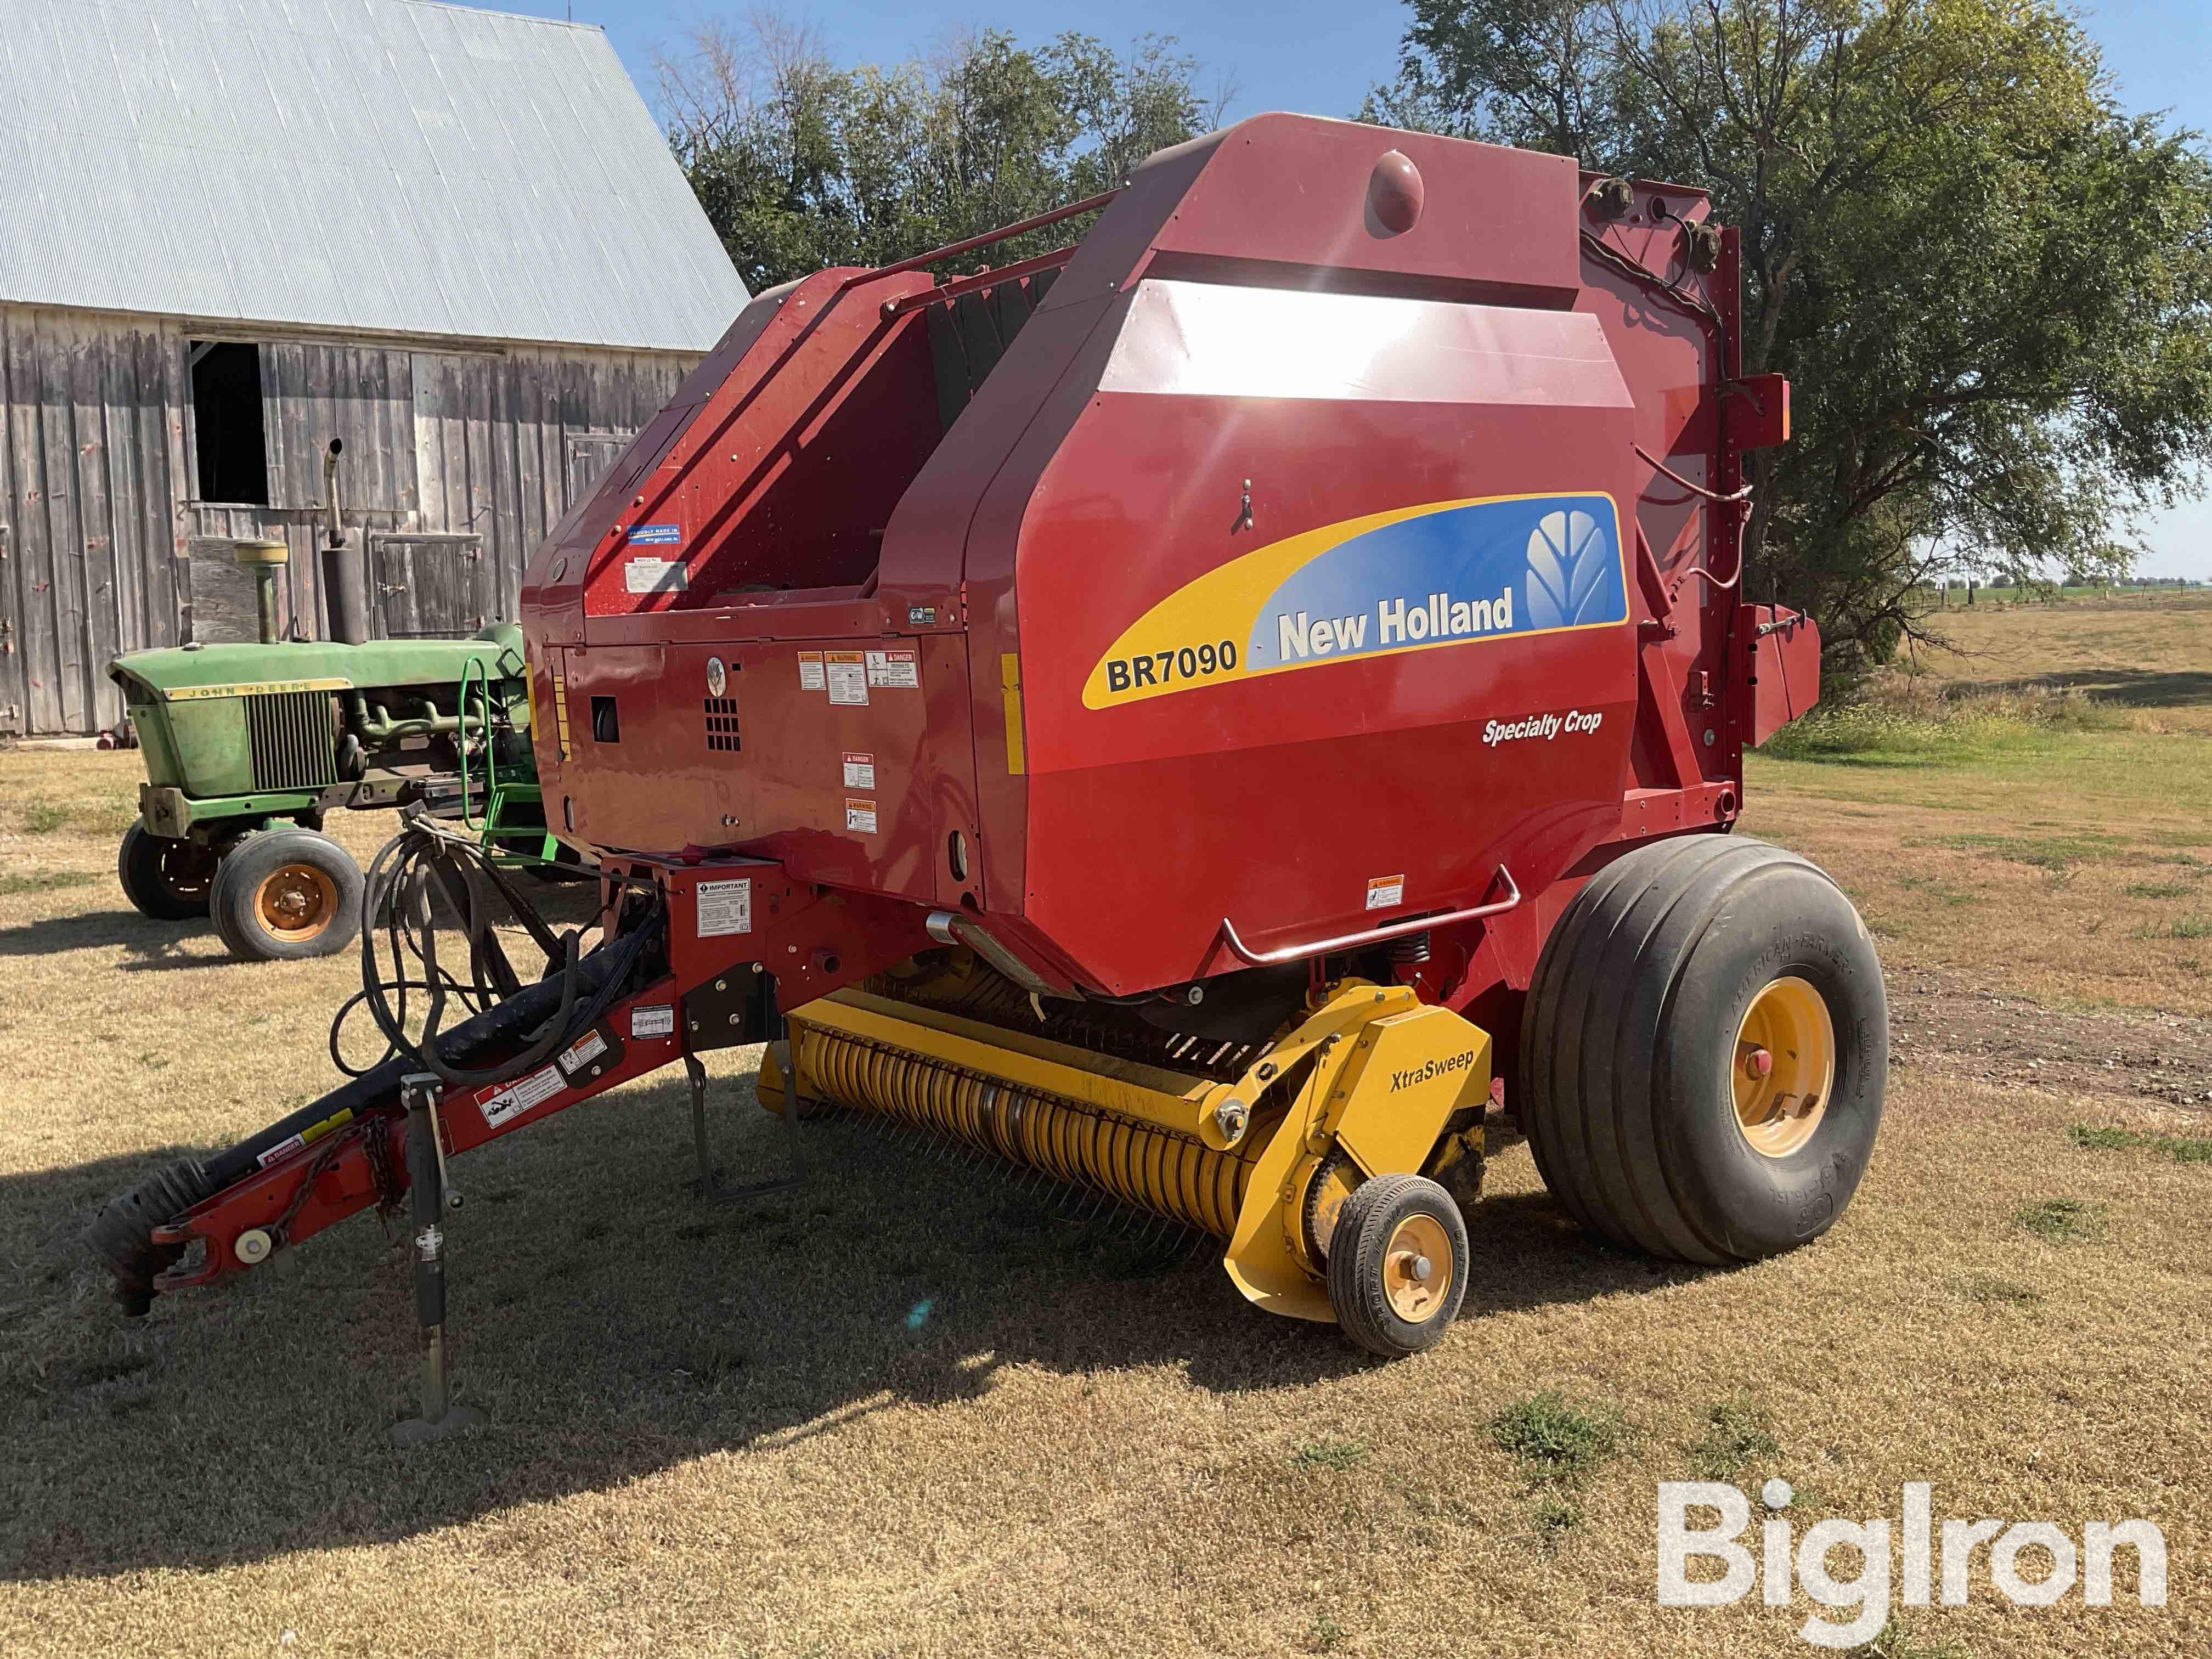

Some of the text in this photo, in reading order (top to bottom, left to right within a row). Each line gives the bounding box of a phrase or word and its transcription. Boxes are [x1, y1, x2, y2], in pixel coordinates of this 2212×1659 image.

[1278, 586, 1513, 661] New Holland
[1107, 640, 1238, 693] BR7090
[189, 682, 312, 698] JOHN DEERE
[1482, 710, 1602, 747] Specialty Crop
[709, 883, 747, 891] IMPORTANT
[1390, 1050, 1474, 1093] XtraSweep
[274, 1139, 301, 1159] DANGER
